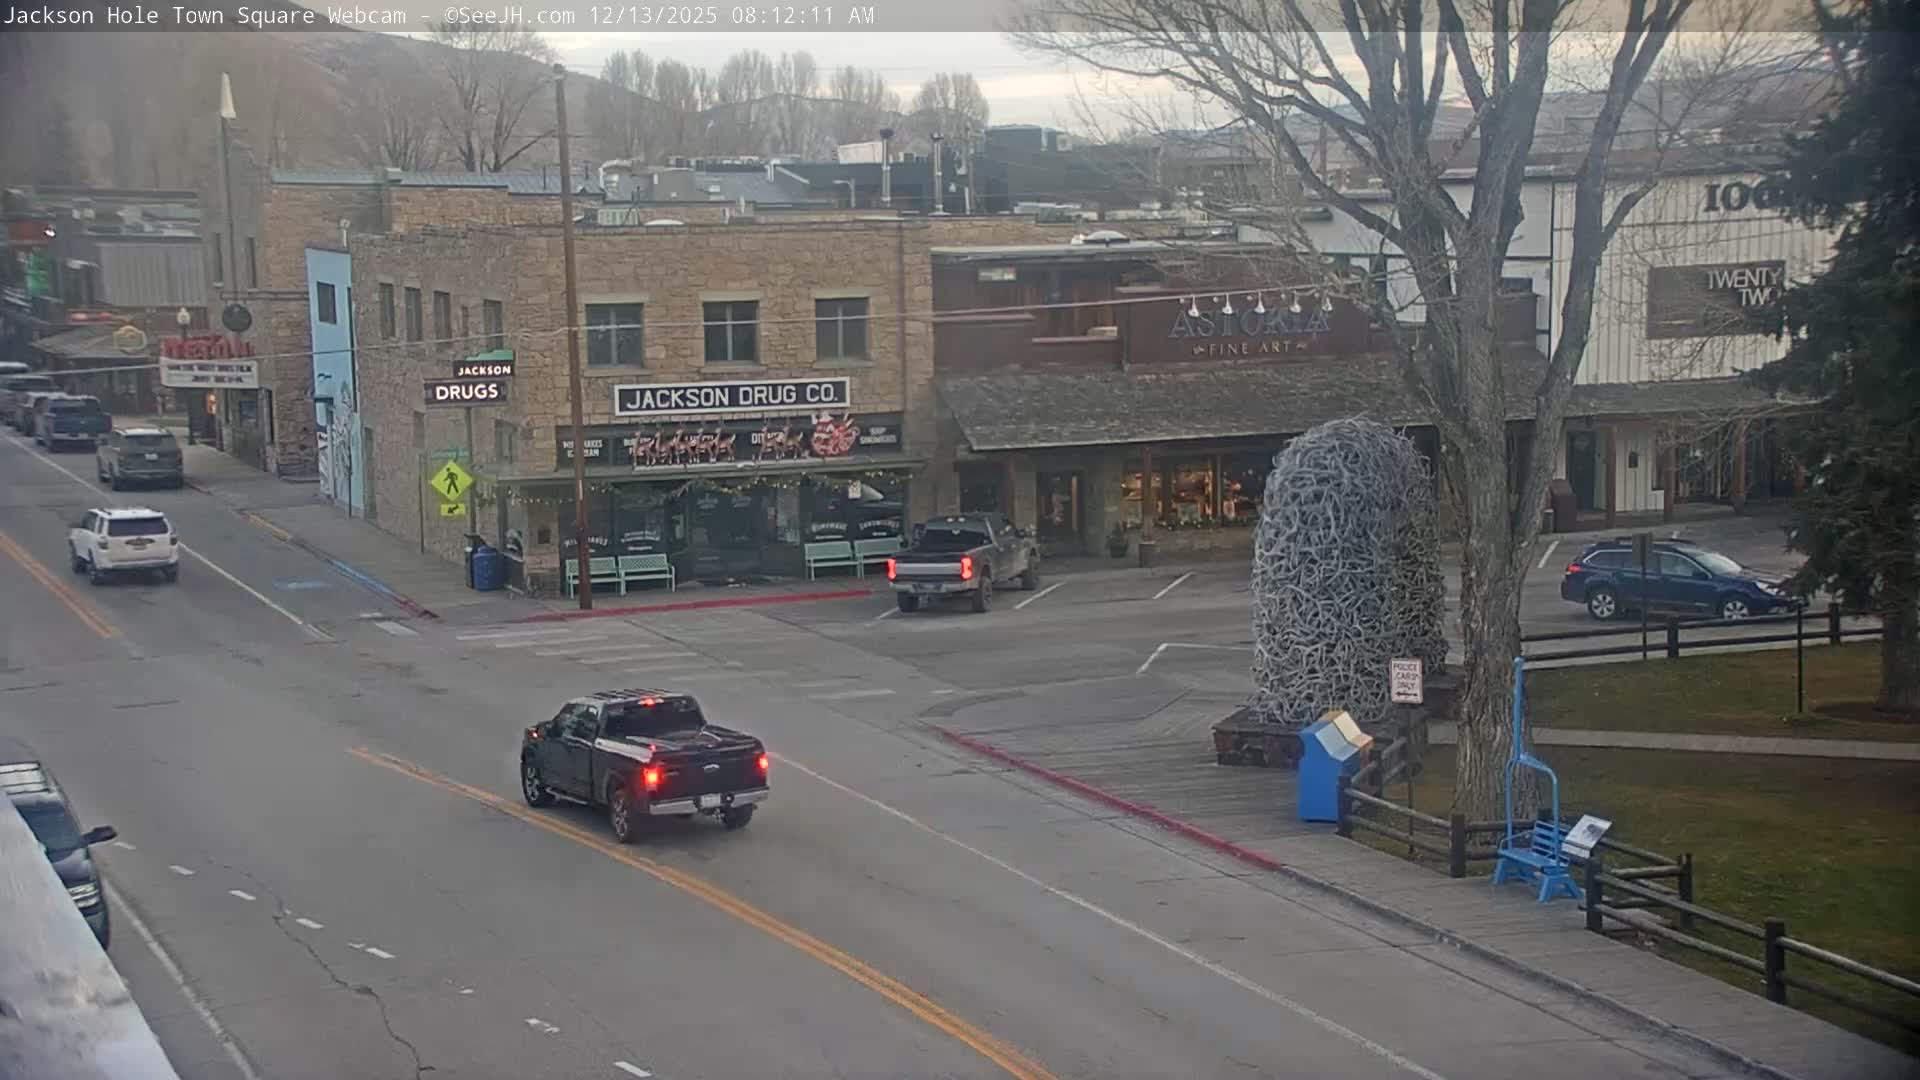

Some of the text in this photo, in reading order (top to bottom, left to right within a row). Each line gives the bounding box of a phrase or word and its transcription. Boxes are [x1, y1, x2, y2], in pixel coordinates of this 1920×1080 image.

[1707, 267, 1781, 289] TWENTY
[1169, 308, 1331, 337] ASTORIA
[1208, 340, 1290, 358] FINE ART
[457, 365, 511, 376] JACKSON
[435, 383, 499, 400] DRUGS
[626, 383, 839, 409] JACKSON DRUG CO.
